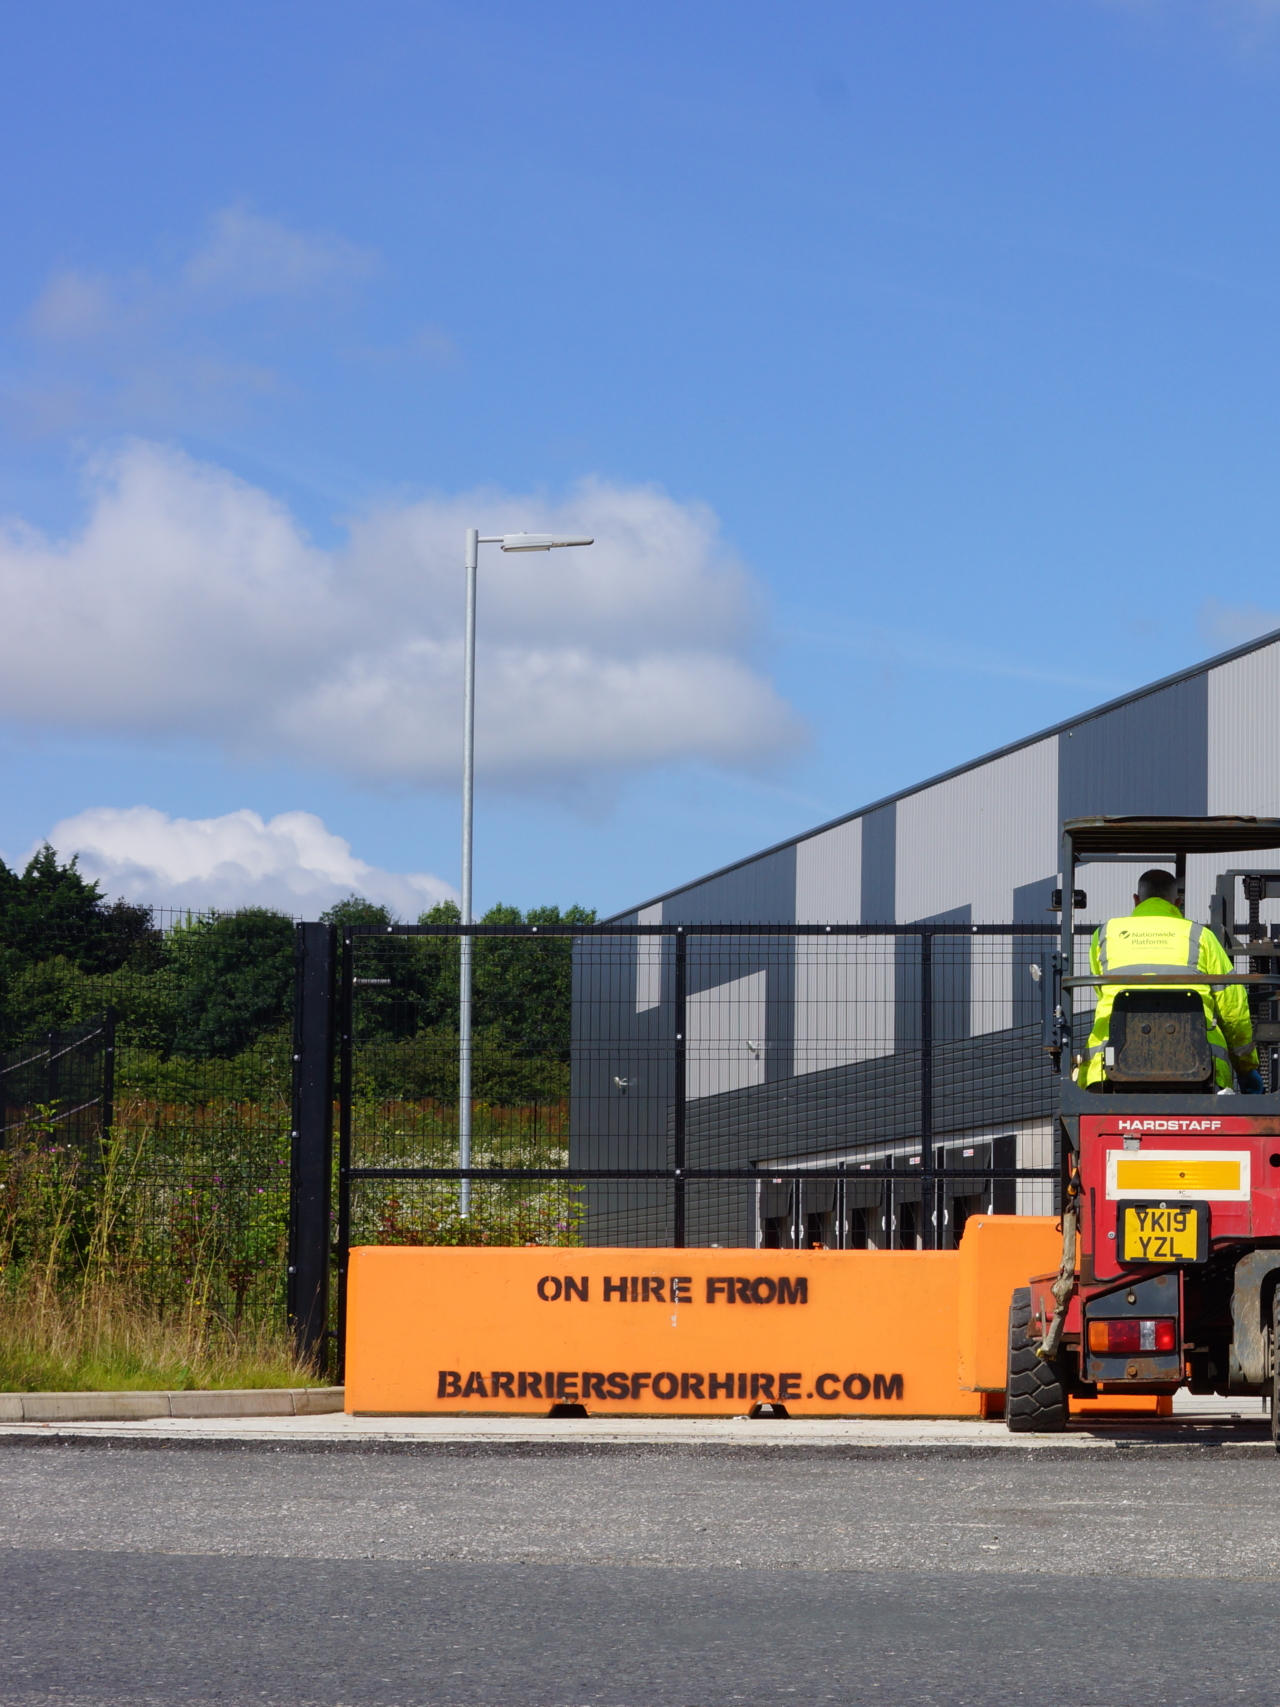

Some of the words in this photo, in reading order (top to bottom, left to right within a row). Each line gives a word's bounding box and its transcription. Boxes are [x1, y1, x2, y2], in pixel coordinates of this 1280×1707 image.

[1118, 1120, 1222, 1131] HARDSTAFF
[1136, 1212, 1187, 1233] YK19
[1138, 1236, 1183, 1257] YZL
[537, 1276, 589, 1302] ON
[603, 1277, 692, 1304] HIRE
[706, 1277, 808, 1305] FROM
[437, 1370, 904, 1400] BARRIERSFORHIRE.COM
